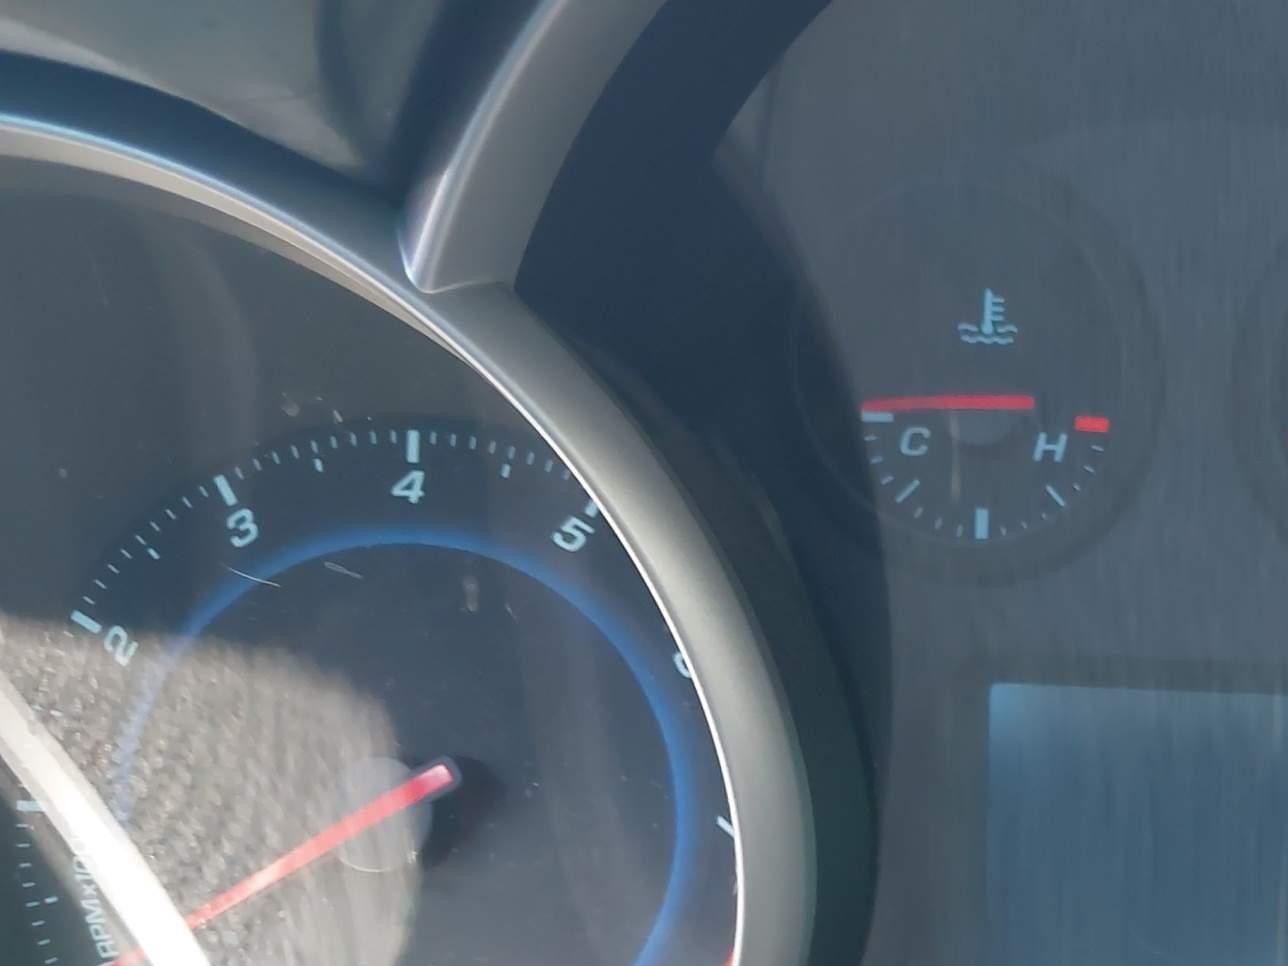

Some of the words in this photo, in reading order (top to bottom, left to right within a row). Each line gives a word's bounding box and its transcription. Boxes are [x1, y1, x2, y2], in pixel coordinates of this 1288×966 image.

[899, 427, 930, 456] C
[1033, 432, 1068, 462] H
[391, 470, 425, 504] 4
[227, 508, 258, 547] 3
[552, 516, 594, 552] 5
[103, 626, 138, 667] 2
